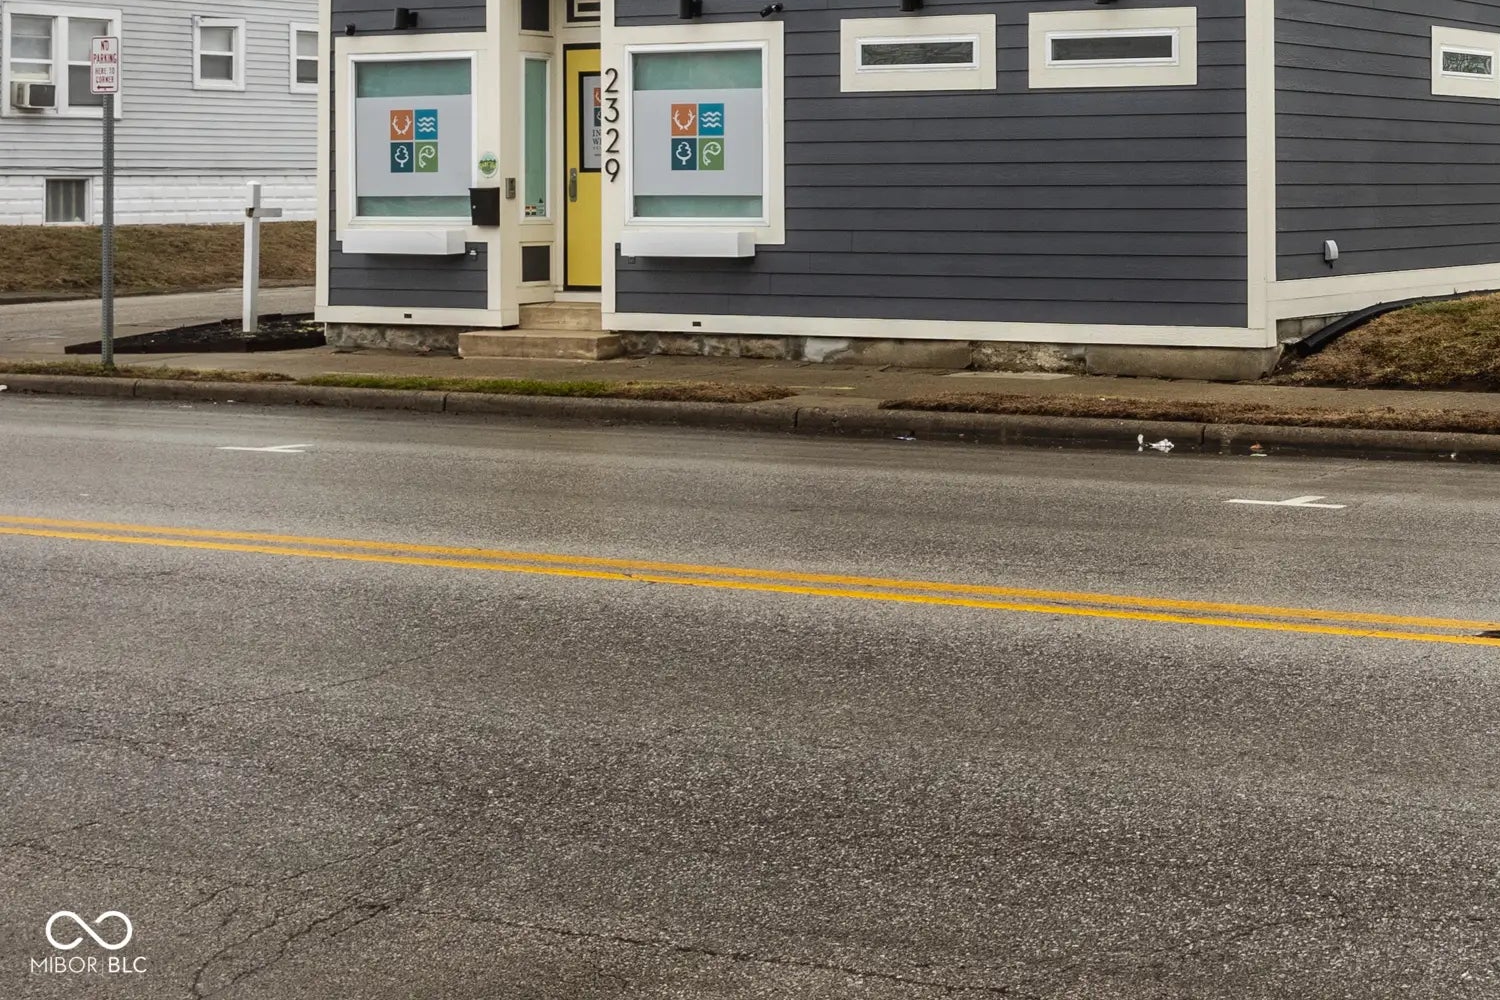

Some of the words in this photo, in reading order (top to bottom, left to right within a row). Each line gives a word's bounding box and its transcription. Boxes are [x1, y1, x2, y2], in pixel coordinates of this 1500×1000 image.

[101, 40, 109, 51] NO
[93, 53, 117, 63] PARKING
[604, 67, 620, 183] 2329
